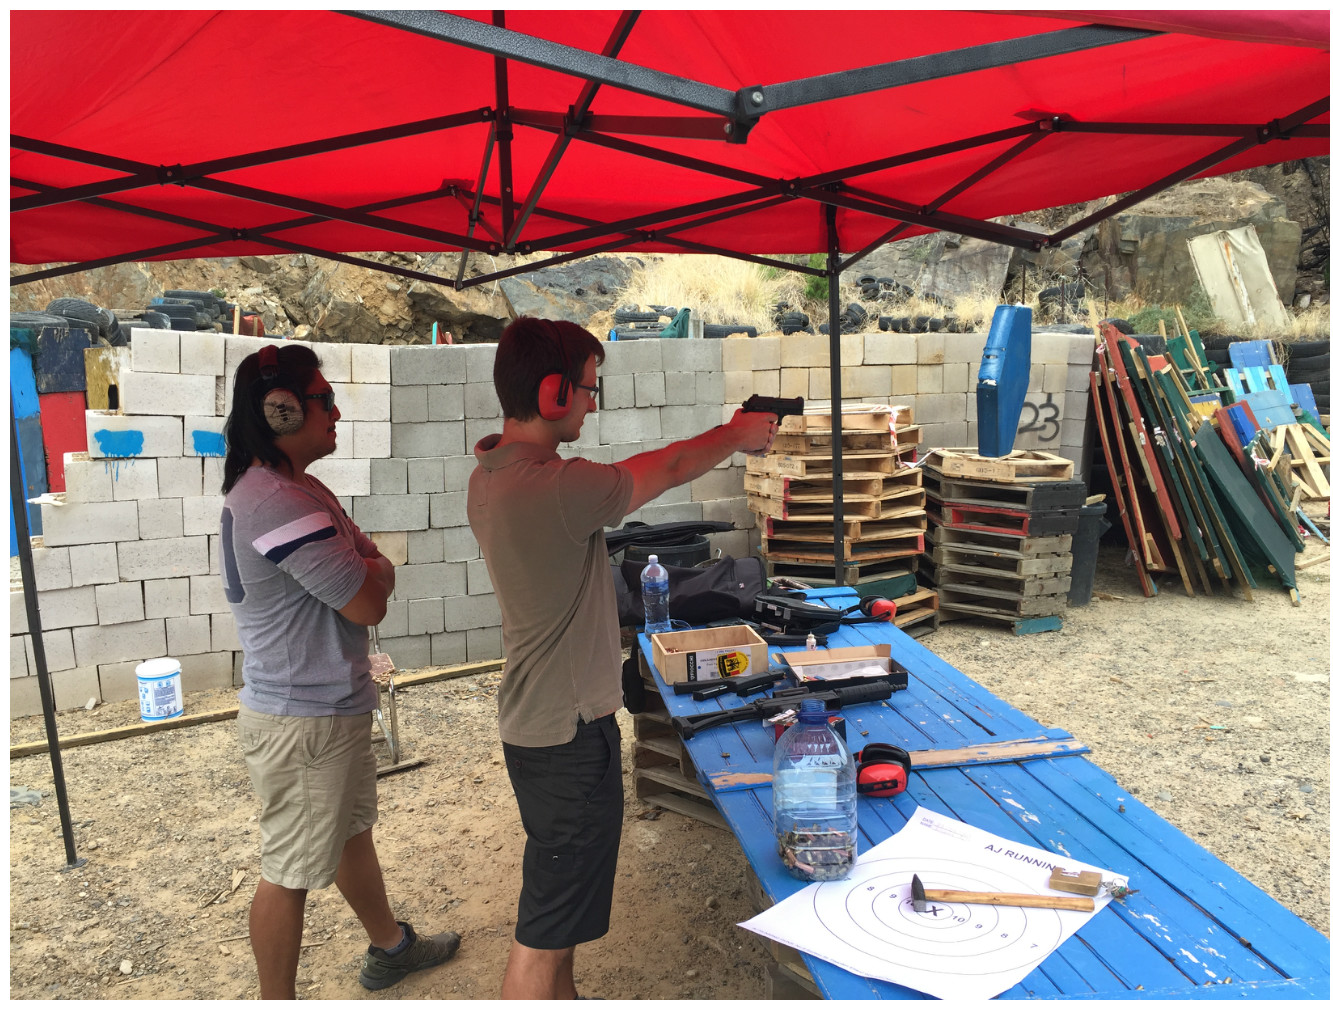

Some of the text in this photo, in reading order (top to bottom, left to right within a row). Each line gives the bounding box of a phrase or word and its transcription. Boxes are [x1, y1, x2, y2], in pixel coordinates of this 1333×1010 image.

[984, 844, 1067, 872] AJ RUNNIN
[952, 915, 966, 923] 10
